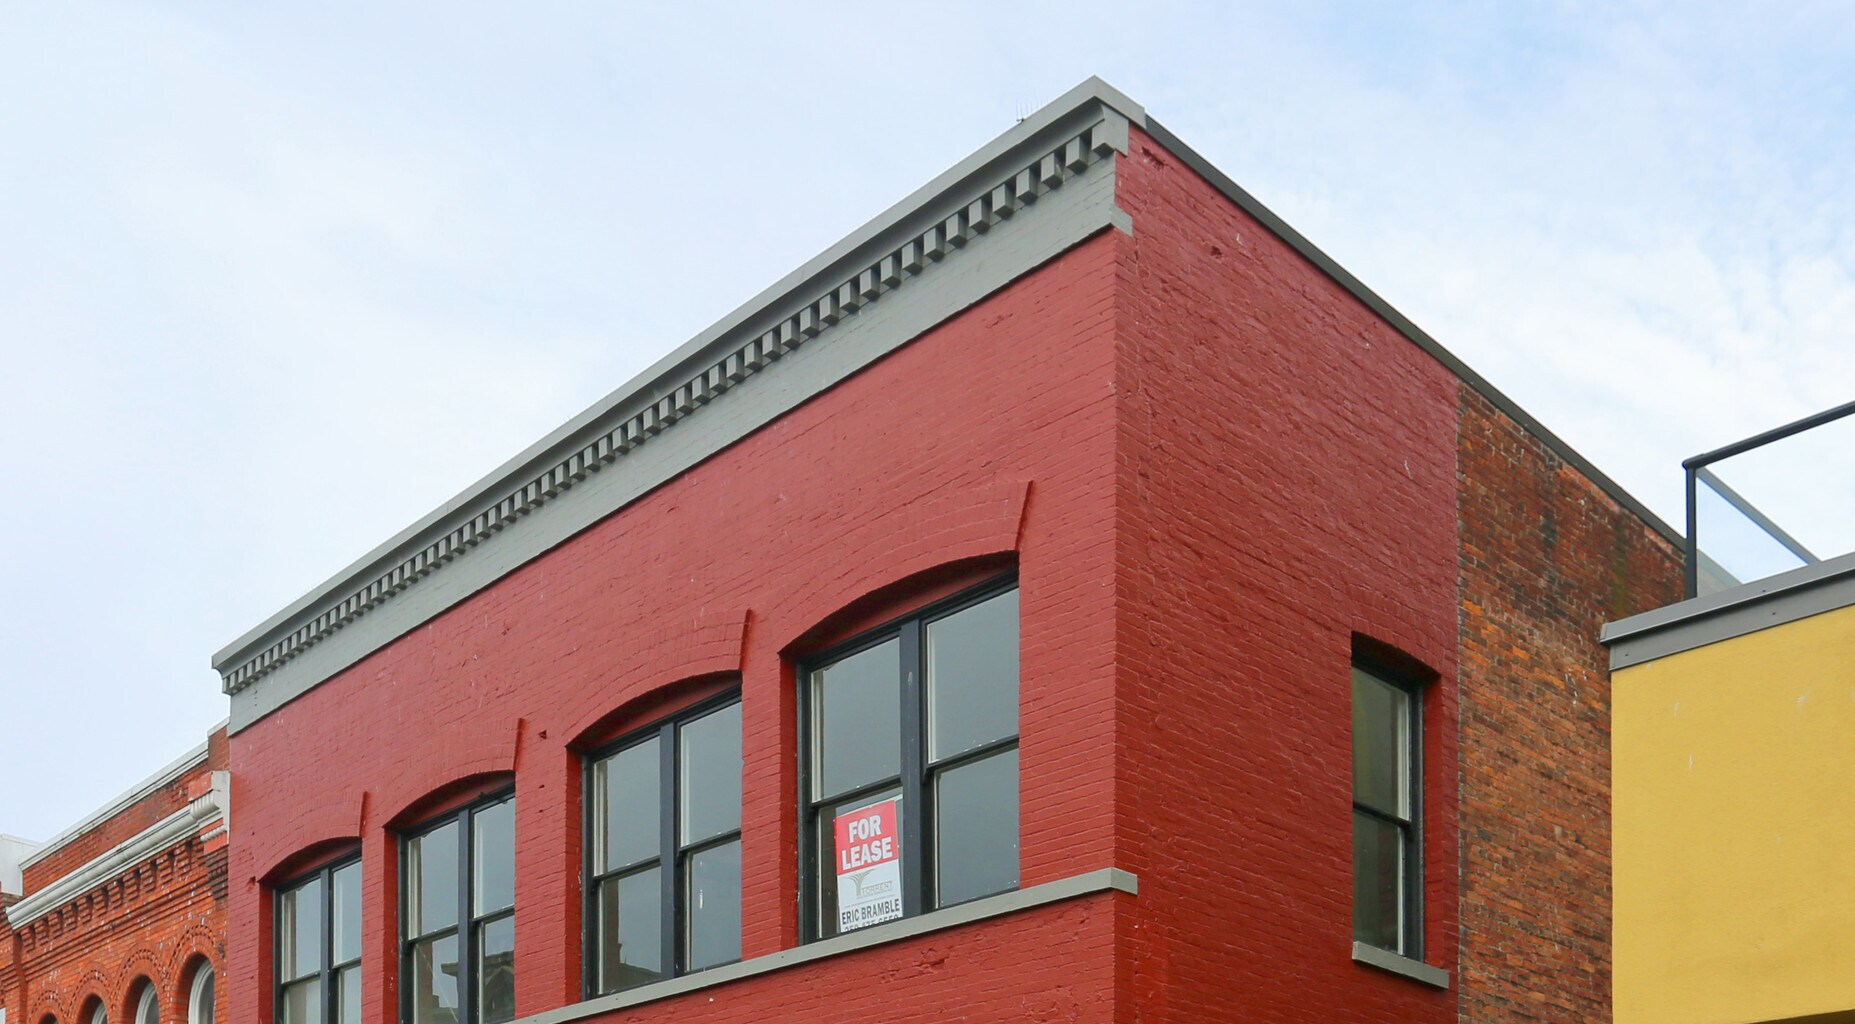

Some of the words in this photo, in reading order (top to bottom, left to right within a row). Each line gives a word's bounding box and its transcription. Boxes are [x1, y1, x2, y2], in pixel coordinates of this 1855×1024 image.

[848, 815, 881, 843] FOR
[842, 837, 893, 870] LEASE
[842, 909, 859, 924] ERIC
[861, 898, 900, 920] BRAMBLE
